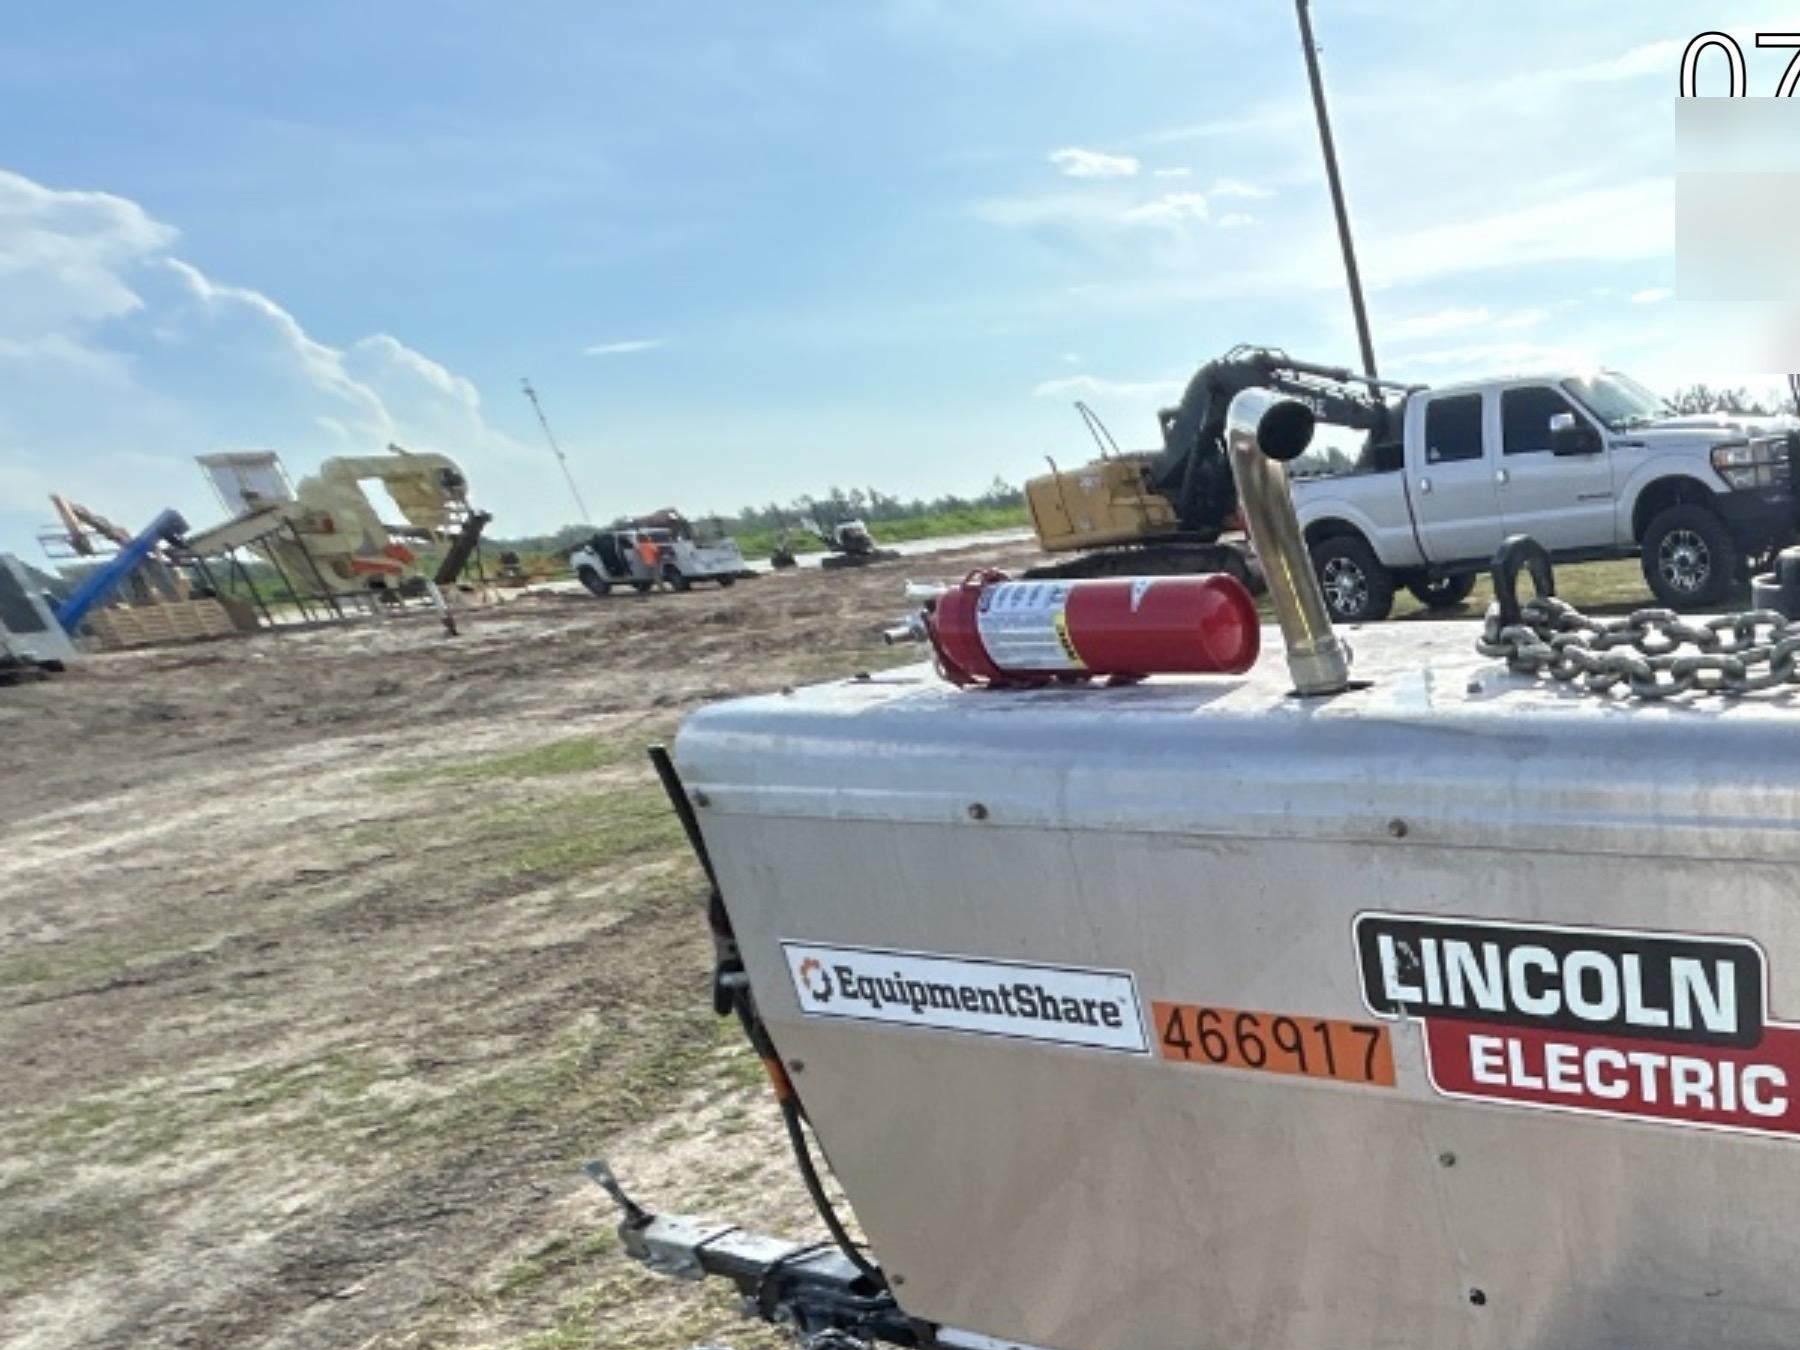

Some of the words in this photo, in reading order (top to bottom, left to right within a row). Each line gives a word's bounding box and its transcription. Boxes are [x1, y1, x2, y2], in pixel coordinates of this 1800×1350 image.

[833, 966, 1122, 1030] EquipmentShare
[1377, 934, 1738, 1034] LINCOLN
[1162, 1006, 1382, 1082] 466917
[1468, 1034, 1789, 1118] ELECTRIC
